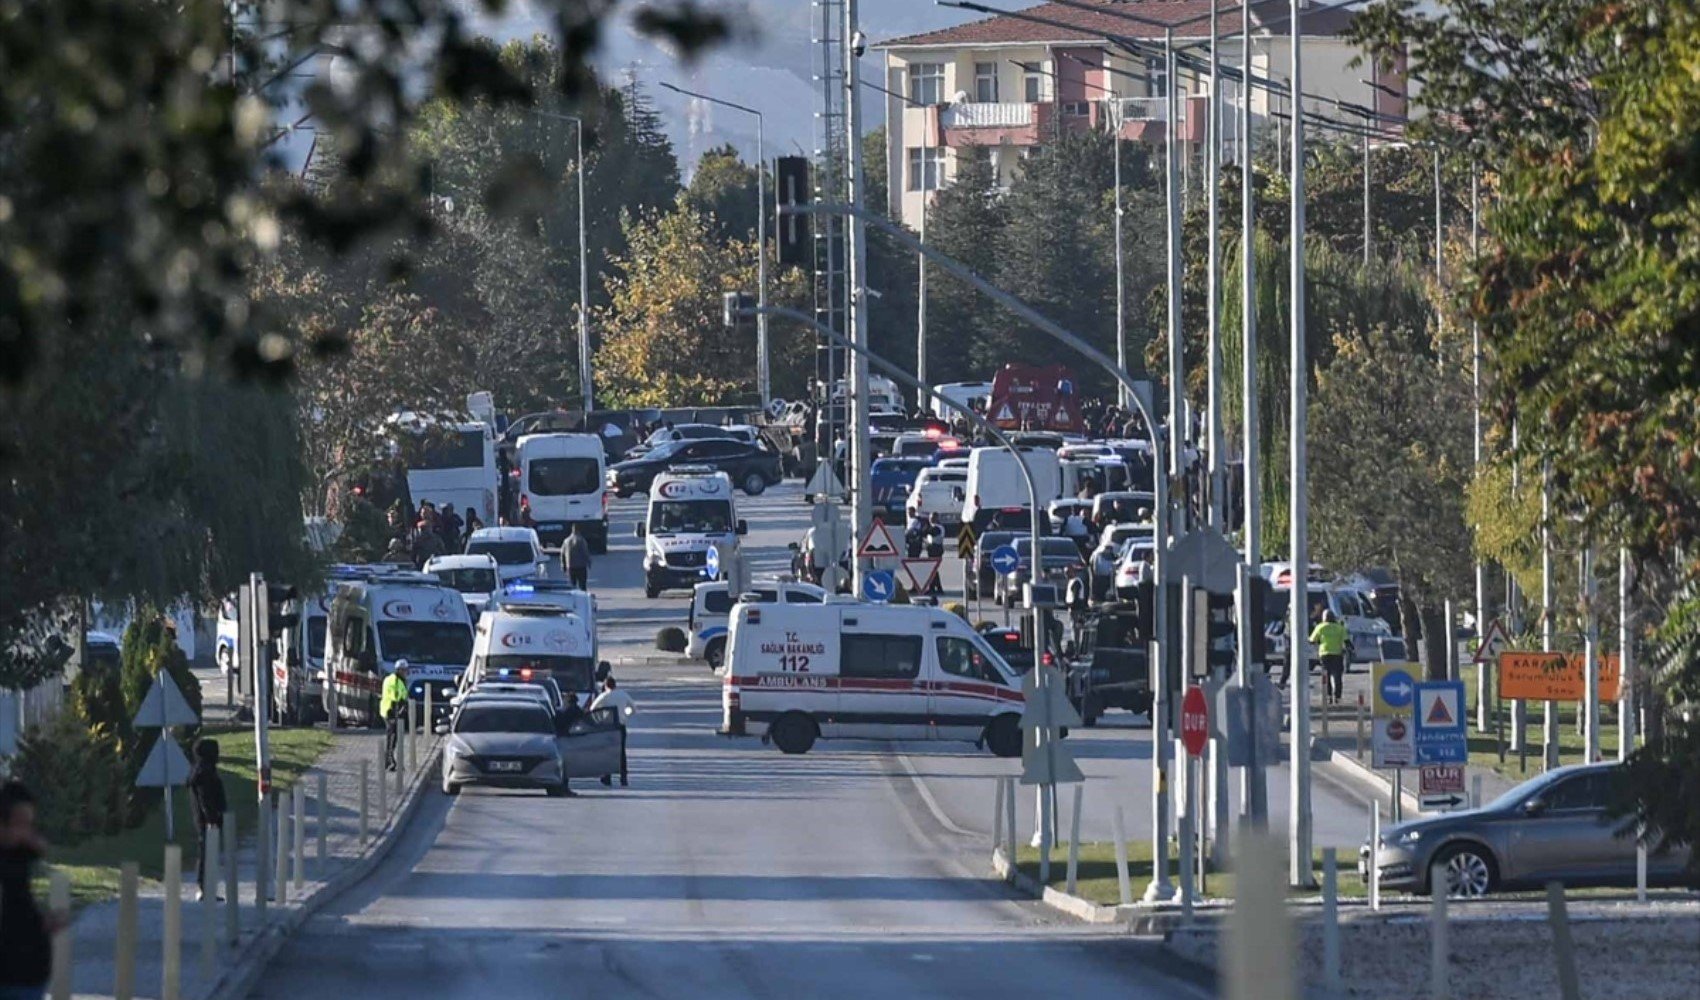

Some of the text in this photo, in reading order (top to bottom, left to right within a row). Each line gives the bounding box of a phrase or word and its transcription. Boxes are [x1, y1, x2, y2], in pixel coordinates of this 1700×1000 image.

[668, 485, 686, 494] 112
[779, 655, 810, 672] 112
[758, 675, 827, 688] AMBULANS
[1184, 712, 1205, 731] DUR
[1424, 767, 1460, 780] DUR
